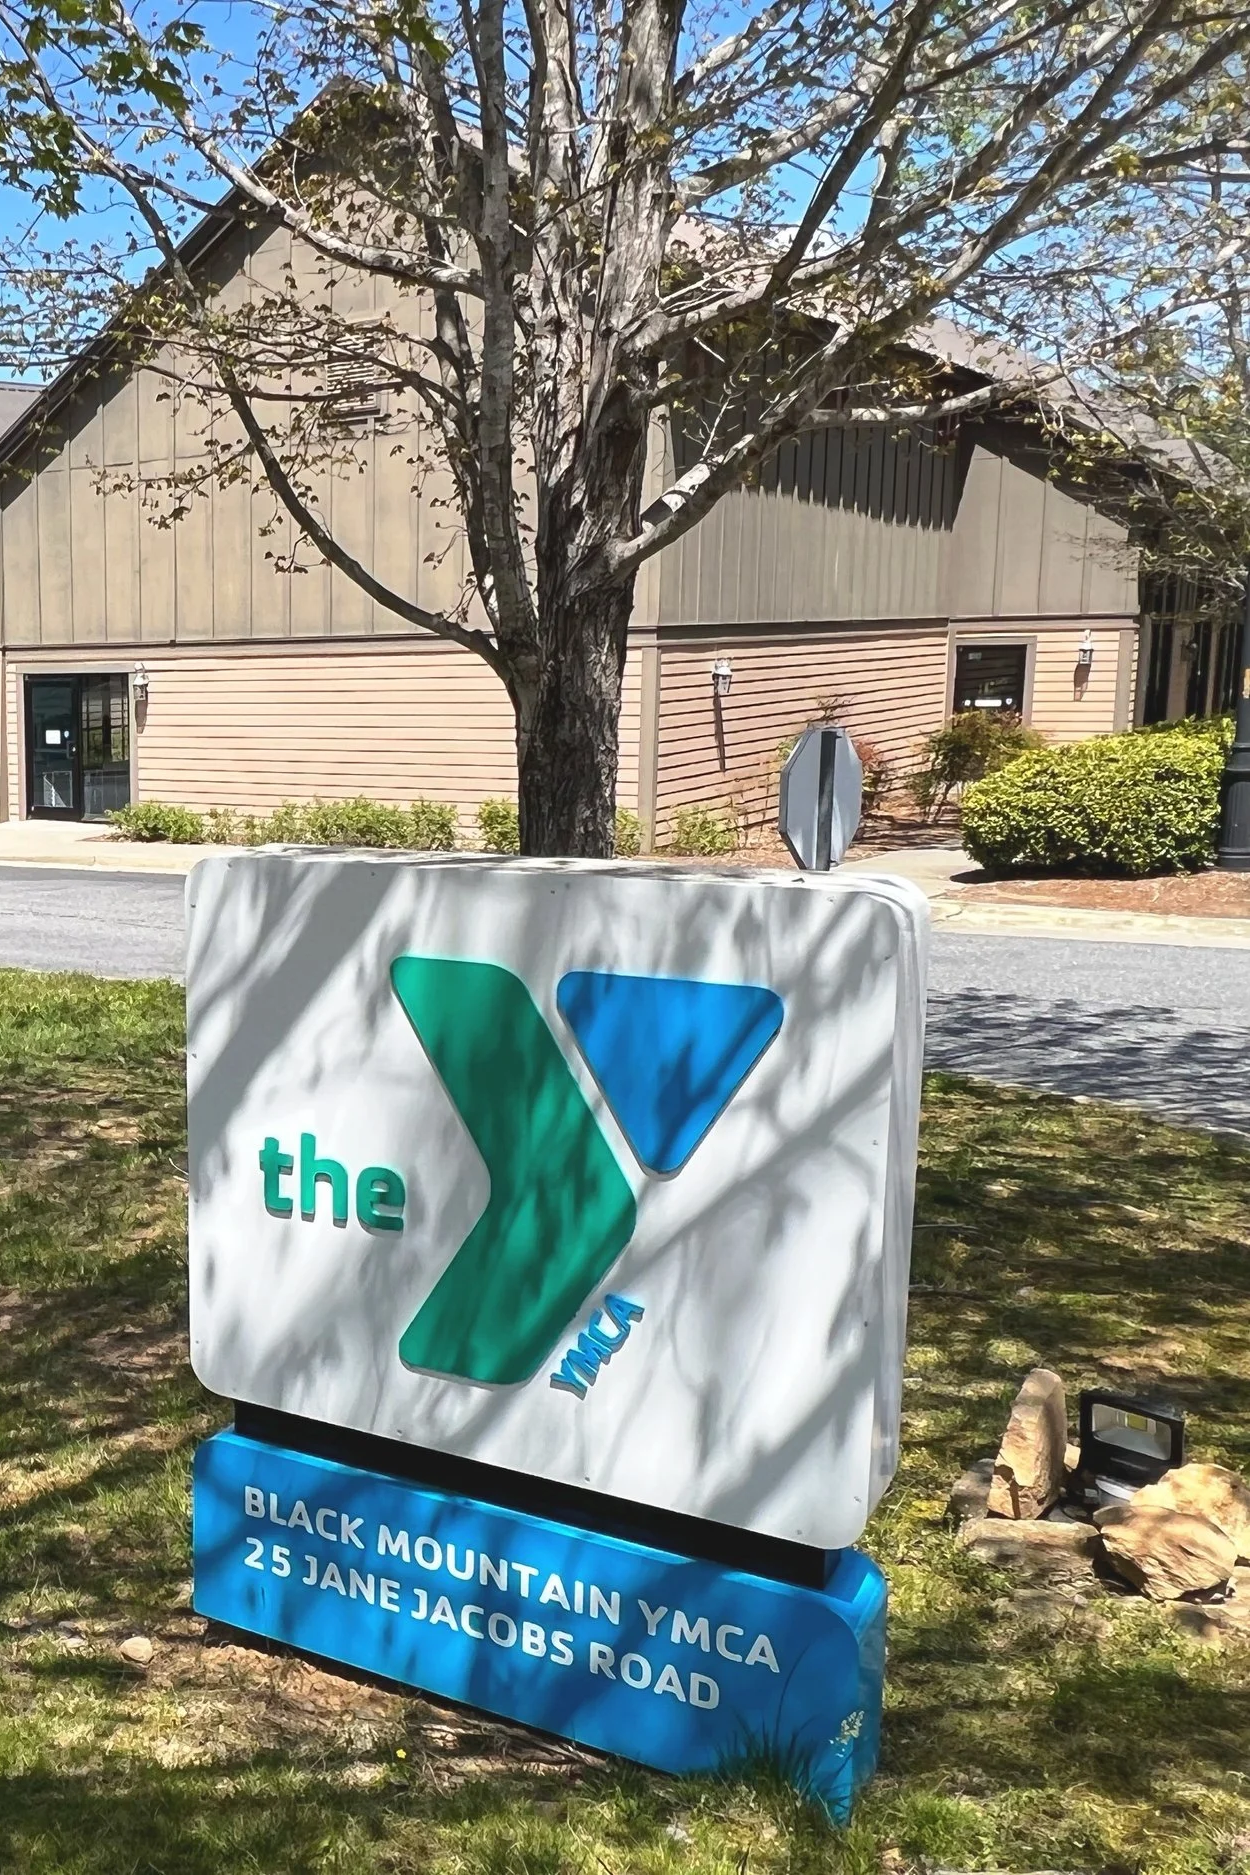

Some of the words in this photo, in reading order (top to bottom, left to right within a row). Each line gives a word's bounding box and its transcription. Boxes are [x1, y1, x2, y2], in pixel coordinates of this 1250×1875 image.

[259, 1133, 405, 1233] the
[550, 1294, 644, 1399] YMCA
[244, 1485, 365, 1549] BLACK
[377, 1524, 620, 1625] MOUNTAIN
[637, 1599, 781, 1673] YMCA
[244, 1537, 291, 1578] 25
[302, 1554, 401, 1613] JANE
[411, 1589, 574, 1666] JACOBS
[589, 1641, 721, 1710] ROAD
